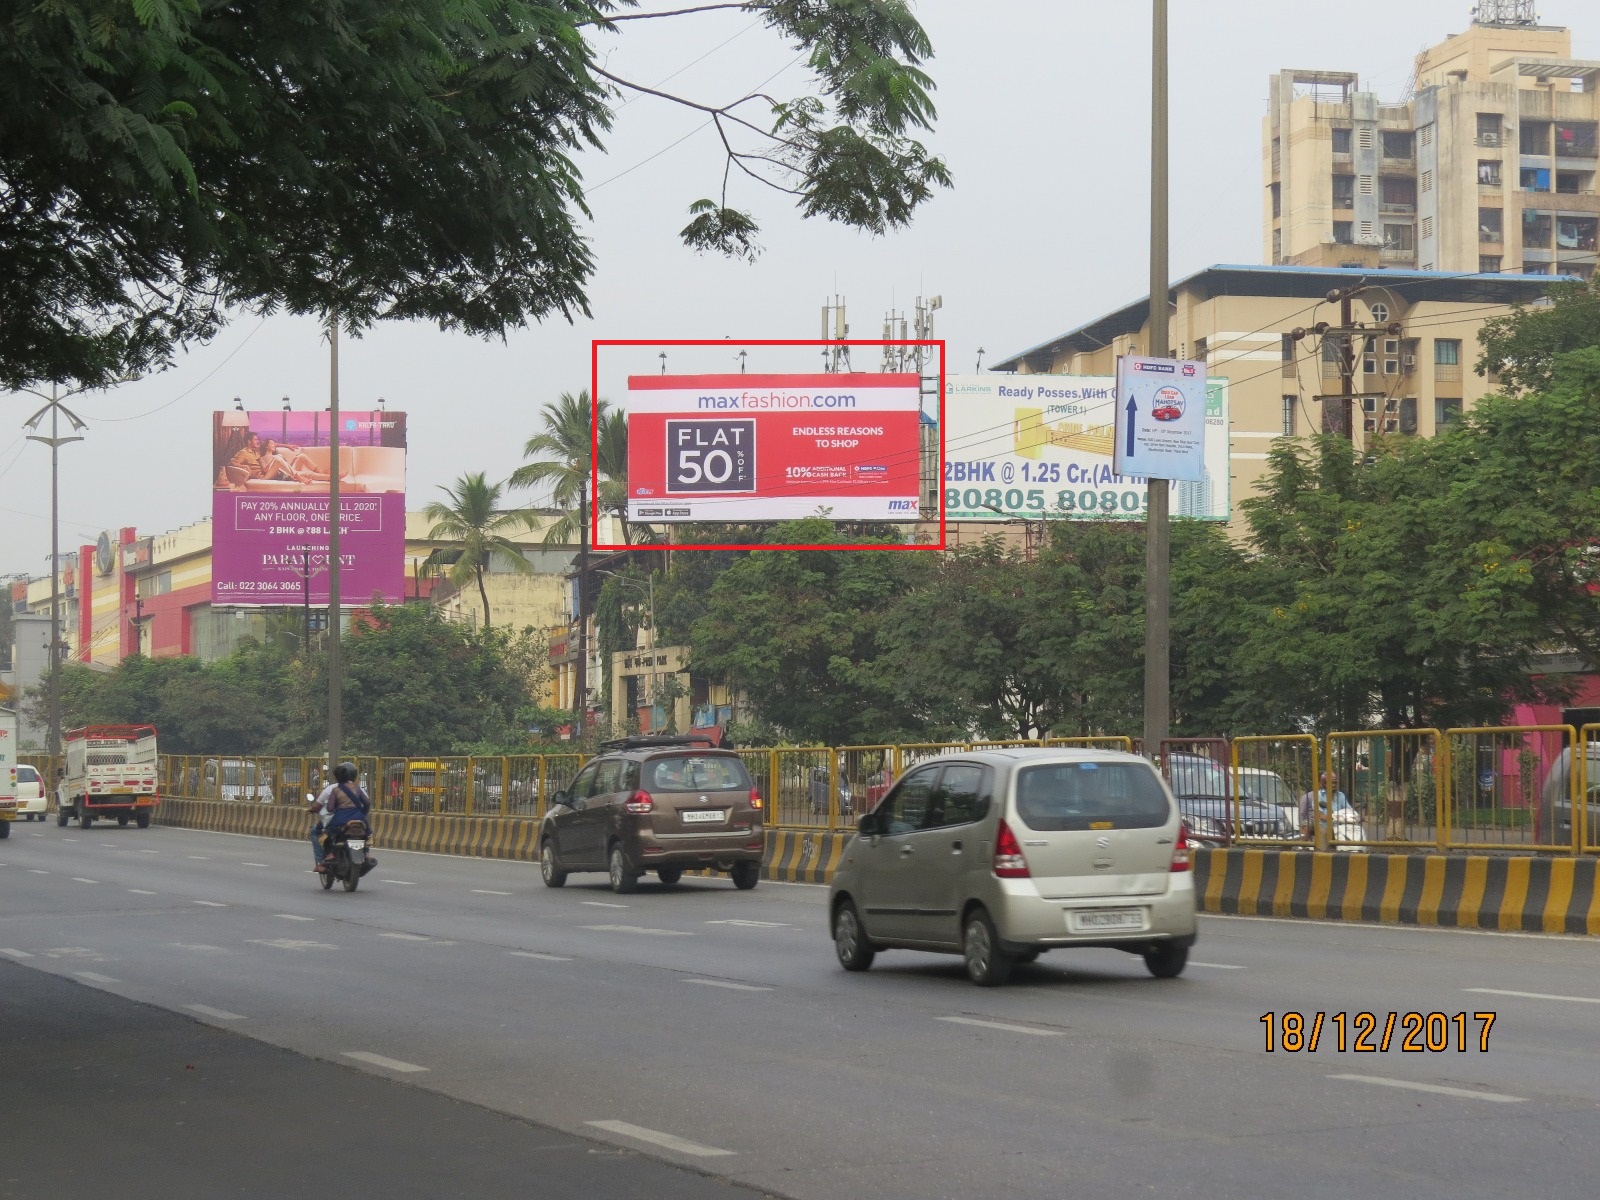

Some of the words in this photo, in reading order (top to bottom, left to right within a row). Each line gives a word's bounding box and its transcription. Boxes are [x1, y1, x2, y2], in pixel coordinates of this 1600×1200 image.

[998, 385, 1034, 399] Ready
[698, 391, 856, 409] maxfashion.com
[678, 428, 745, 446] FLAT
[792, 427, 836, 436] ENDLESS
[837, 426, 884, 436] REASONS
[815, 439, 830, 448] TO
[831, 439, 859, 448] SHOP
[677, 449, 733, 484] 50
[785, 466, 812, 478] 10%
[1001, 462, 1015, 484] @
[1021, 463, 1061, 483] 1.25
[888, 500, 918, 510] max
[945, 488, 1045, 510] 80805
[241, 502, 258, 511] PAY
[259, 502, 278, 511] 20%
[280, 502, 330, 511] ANNUALLY
[254, 513, 273, 521] ANY
[275, 513, 309, 522] FLOOR,
[310, 513, 330, 521] ONE
[339, 513, 363, 522] RICE.
[217, 581, 237, 590] Call:
[239, 581, 255, 591] 022
[257, 582, 278, 591] 3064
[279, 582, 301, 591] 3065
